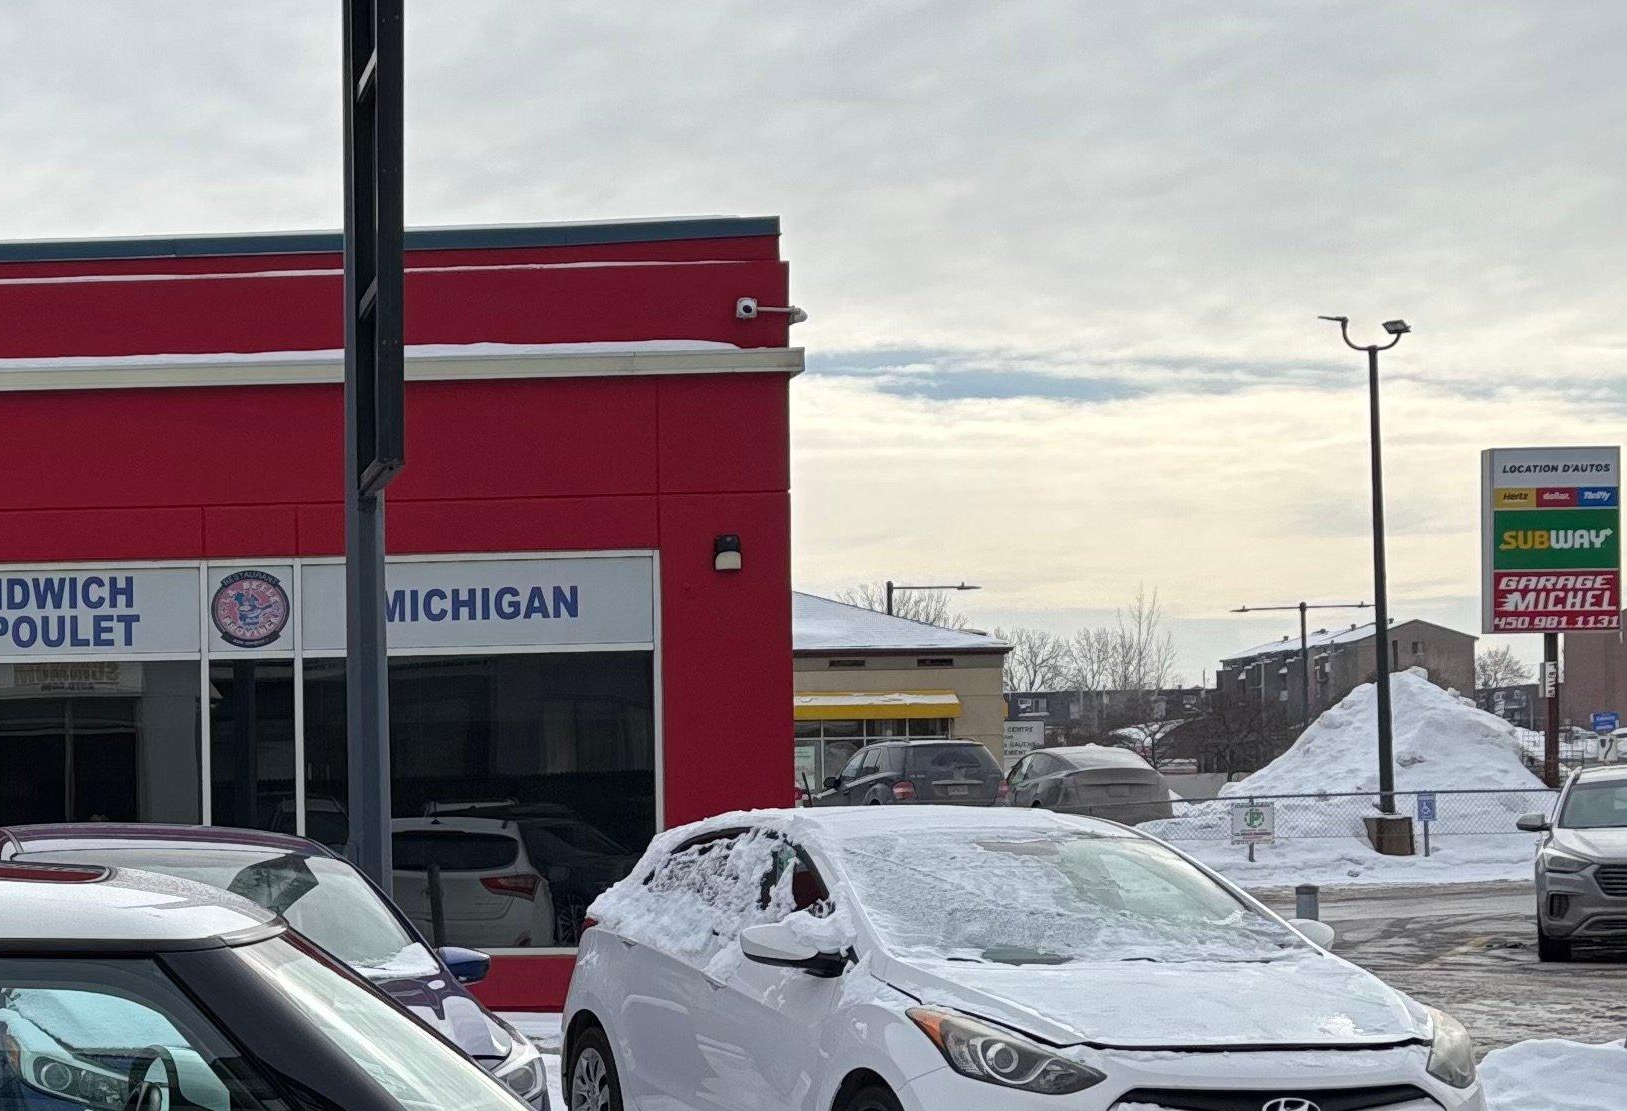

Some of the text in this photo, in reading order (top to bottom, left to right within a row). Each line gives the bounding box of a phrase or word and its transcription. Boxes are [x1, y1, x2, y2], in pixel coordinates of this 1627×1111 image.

[1502, 463, 1611, 474] LOCATION D'AUTOS
[1503, 492, 1528, 500] Hertz
[1499, 528, 1613, 549] SUBWAY
[1498, 575, 1614, 590] GARAGE
[1506, 590, 1617, 611] MICHEL
[1494, 615, 1619, 629] 450.981.1131
